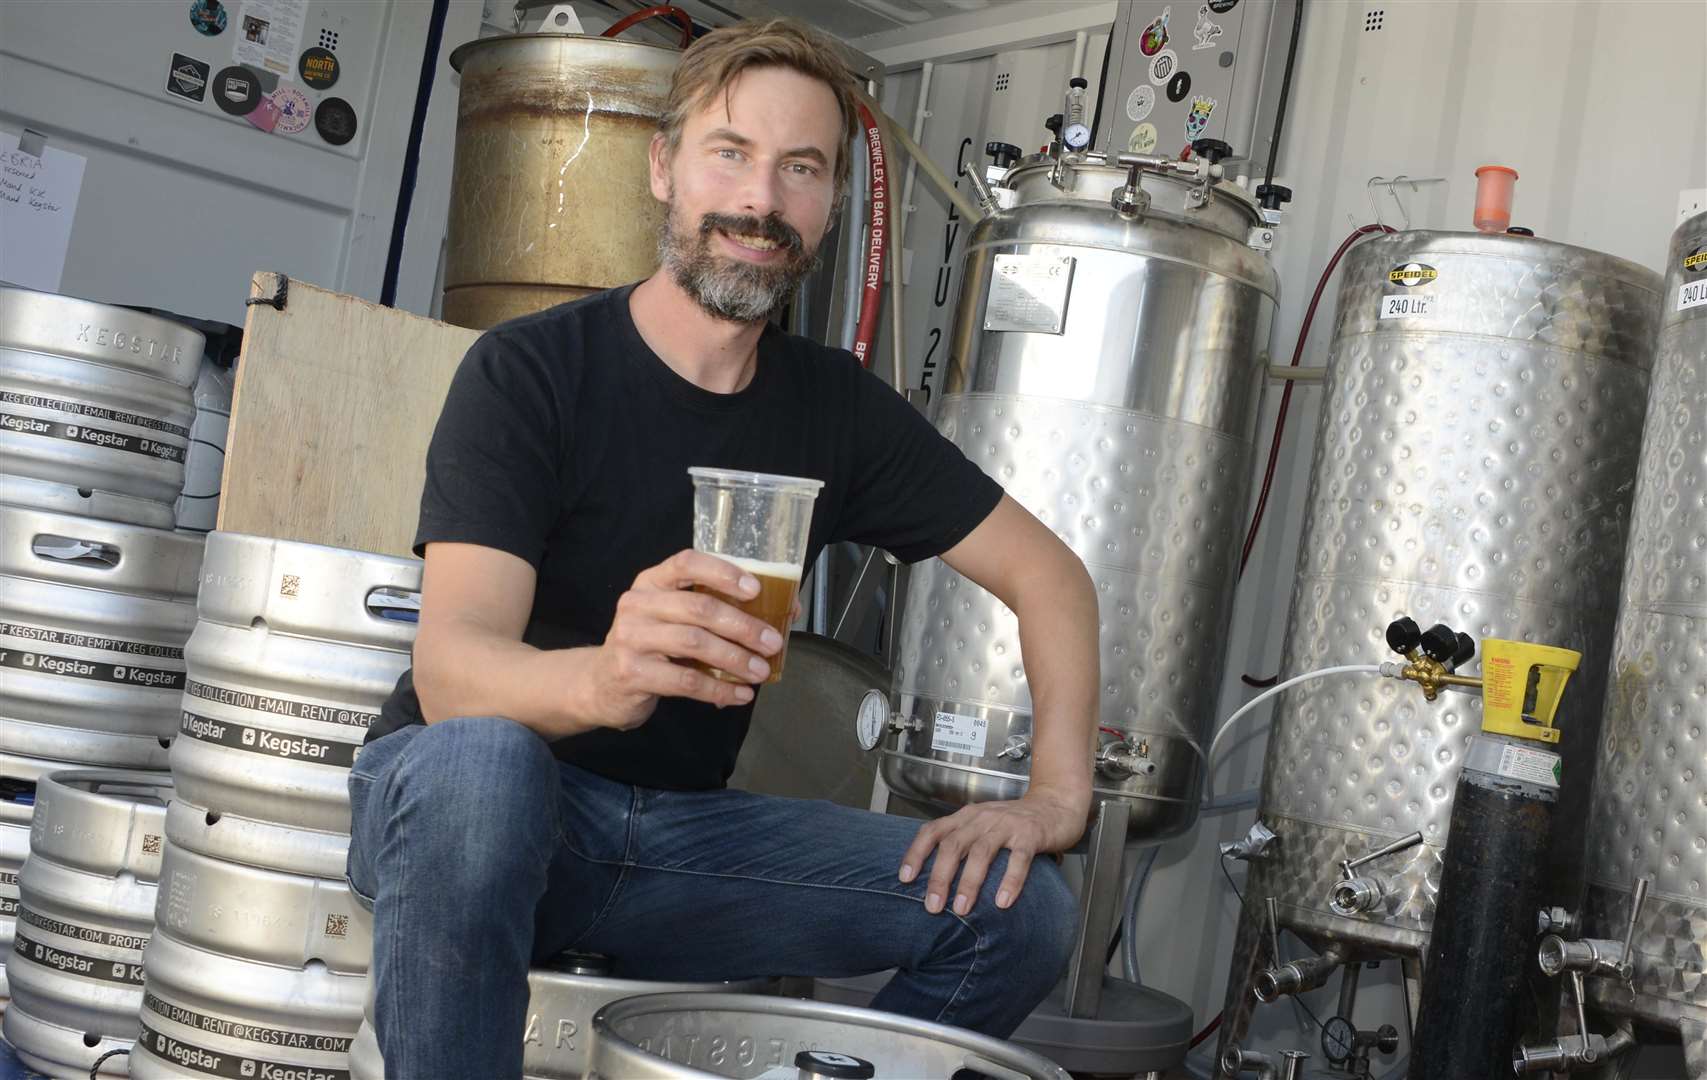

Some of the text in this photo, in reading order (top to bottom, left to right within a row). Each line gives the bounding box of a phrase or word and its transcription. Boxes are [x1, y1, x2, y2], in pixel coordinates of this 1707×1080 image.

[306, 57, 335, 71] NORTH
[866, 127, 884, 290] BREWFLEX 10 BAR DELIVERY
[1391, 270, 1434, 279] SPEIDEL
[1683, 285, 1698, 304] 240
[1389, 299, 1409, 314] 240
[76, 323, 183, 365] KEGSTAR
[2, 392, 20, 404] KEG
[23, 395, 81, 415] COLLECTION
[84, 406, 113, 421] EMAIL
[0, 414, 50, 433] Kegstar
[81, 428, 129, 447] Kegstar
[62, 633, 85, 646] FOR
[87, 637, 124, 652] EMPTY
[127, 643, 146, 655] KEG
[38, 655, 96, 675] Kegstar
[129, 669, 177, 686] Kegstar
[202, 685, 255, 708] COLLECTION
[258, 697, 297, 716] EMAIL
[188, 715, 227, 739] Kegstar
[259, 731, 330, 757] Kegstar
[46, 946, 94, 972] Kegstar
[171, 1007, 200, 1028] EMAIL
[167, 1038, 221, 1070] Kegstar
